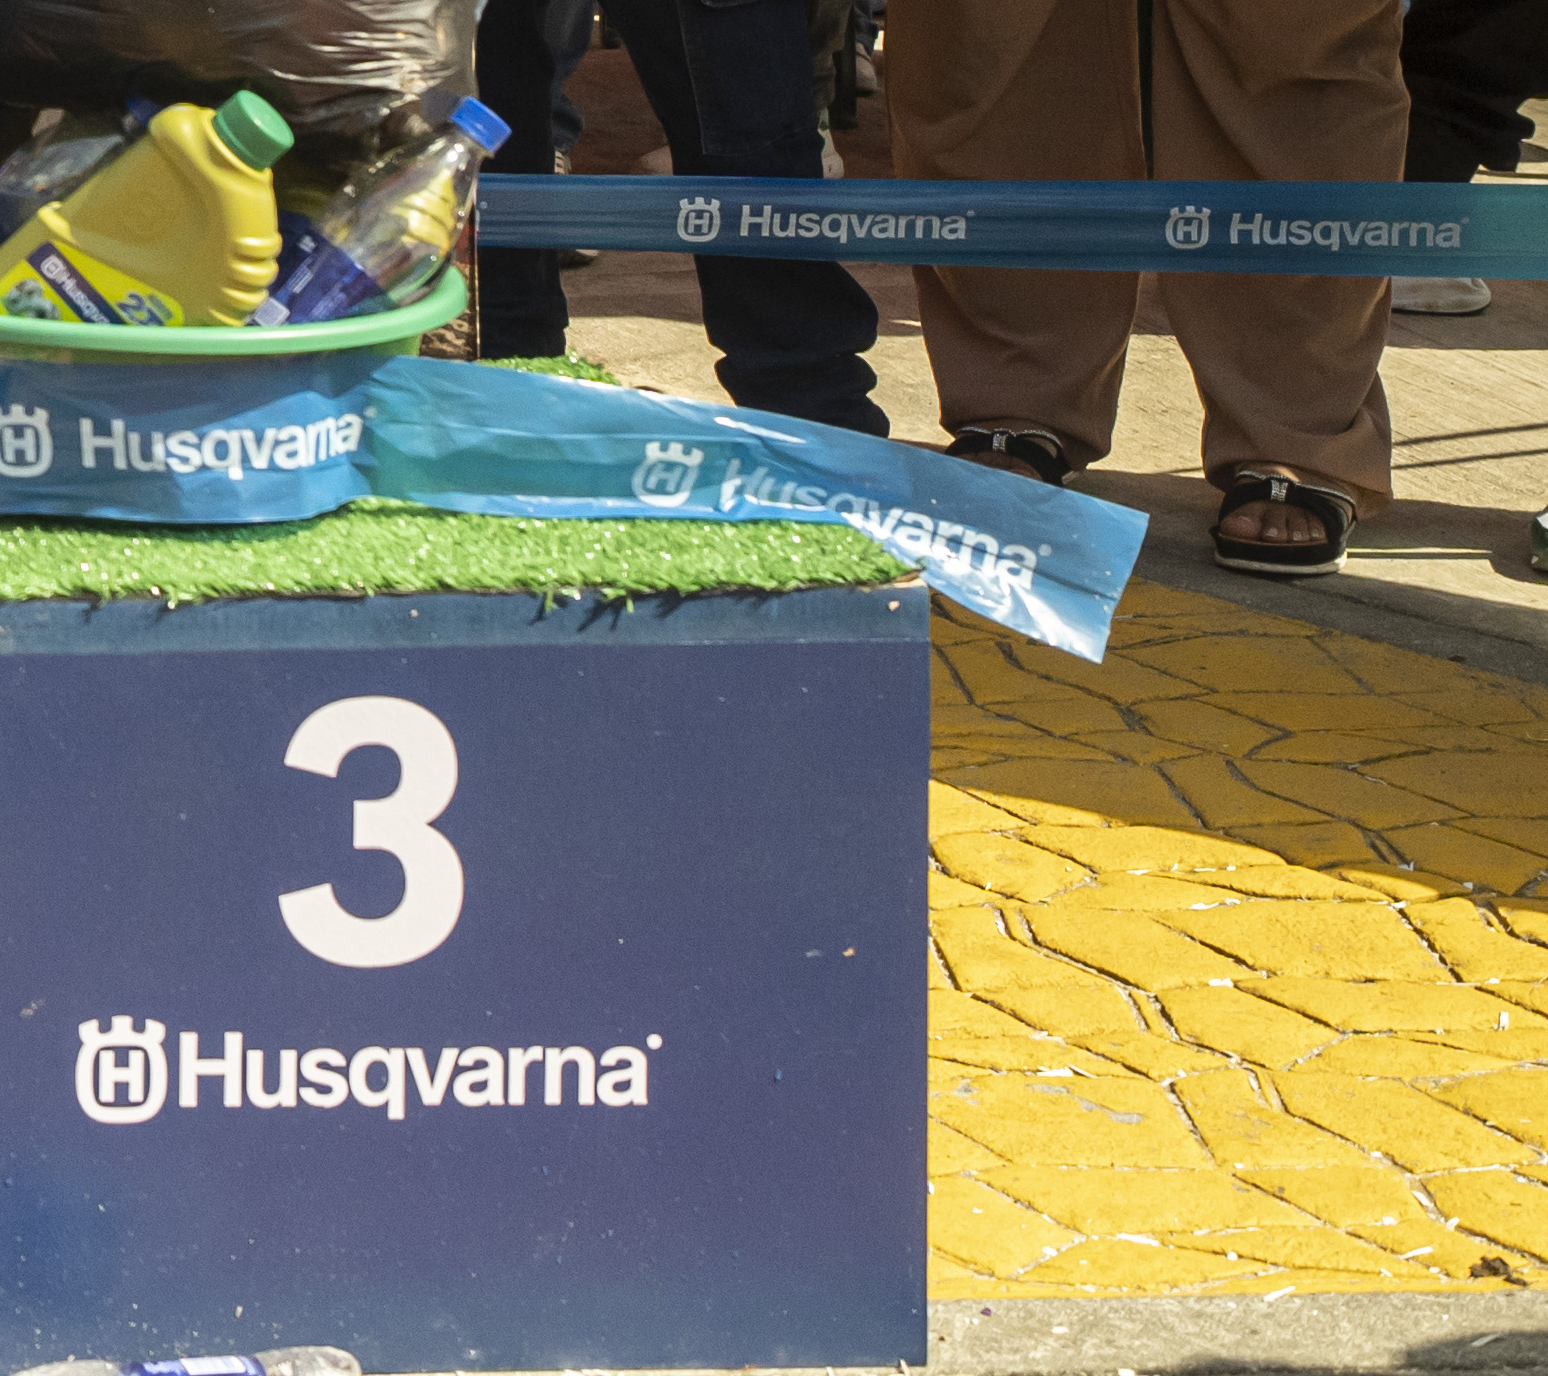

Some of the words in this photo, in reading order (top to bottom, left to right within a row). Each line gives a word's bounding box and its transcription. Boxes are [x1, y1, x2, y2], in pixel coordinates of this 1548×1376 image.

[739, 205, 968, 245] Husqvarna
[1229, 212, 1461, 252] Husqvarna
[78, 404, 364, 482] Husqvarna
[722, 458, 1039, 595] Husqvarna
[277, 694, 467, 969] 3
[179, 1031, 649, 1122] Husqvarna
